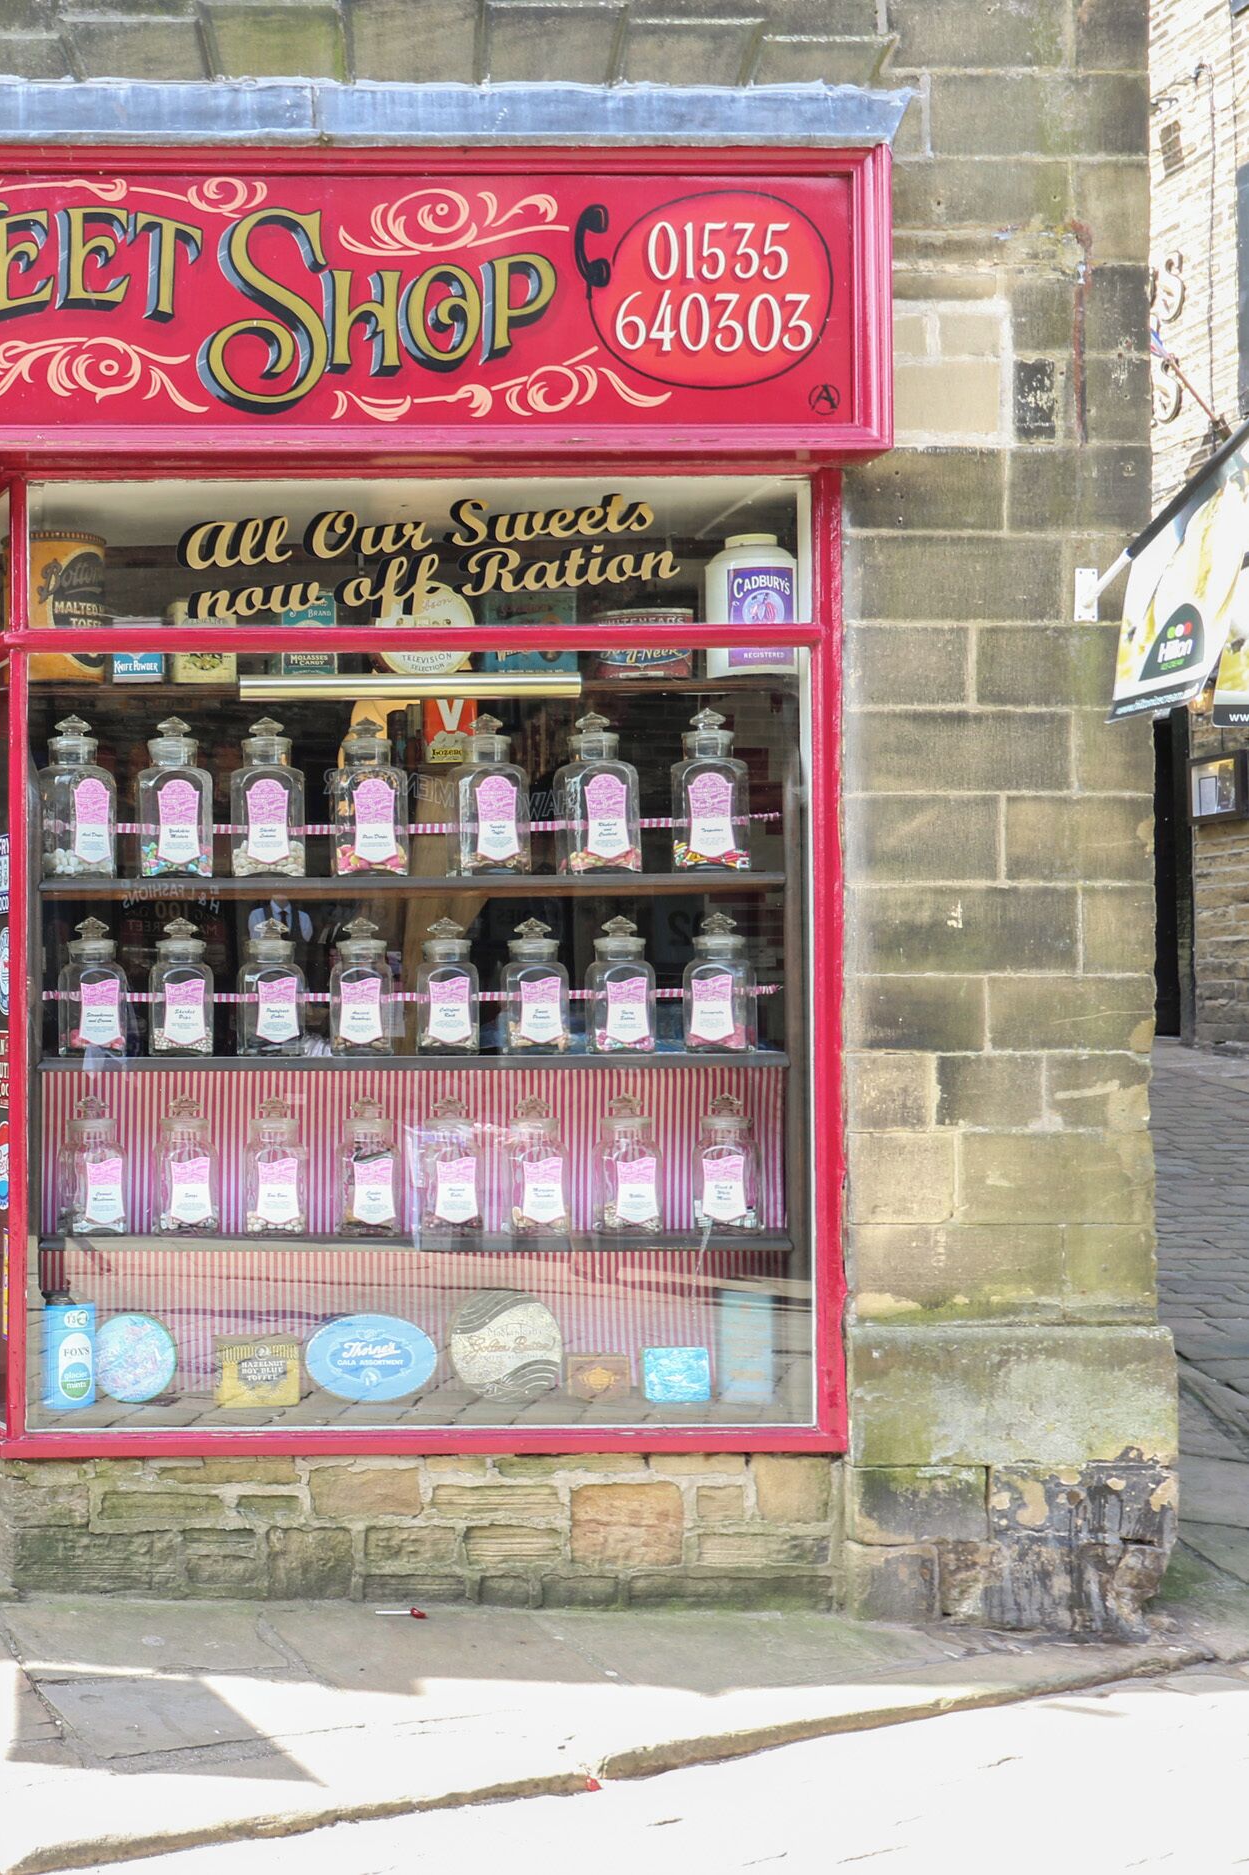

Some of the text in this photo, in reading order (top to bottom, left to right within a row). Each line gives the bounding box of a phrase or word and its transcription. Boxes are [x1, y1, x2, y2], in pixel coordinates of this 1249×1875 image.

[648, 219, 792, 282] 01535
[196, 206, 557, 416] SHOP
[615, 290, 815, 354] 640303
[177, 493, 655, 571] All Our Sweets
[188, 543, 681, 620] now off Ration
[733, 574, 791, 598] CADBURY'S
[402, 652, 452, 662] TELEVISION
